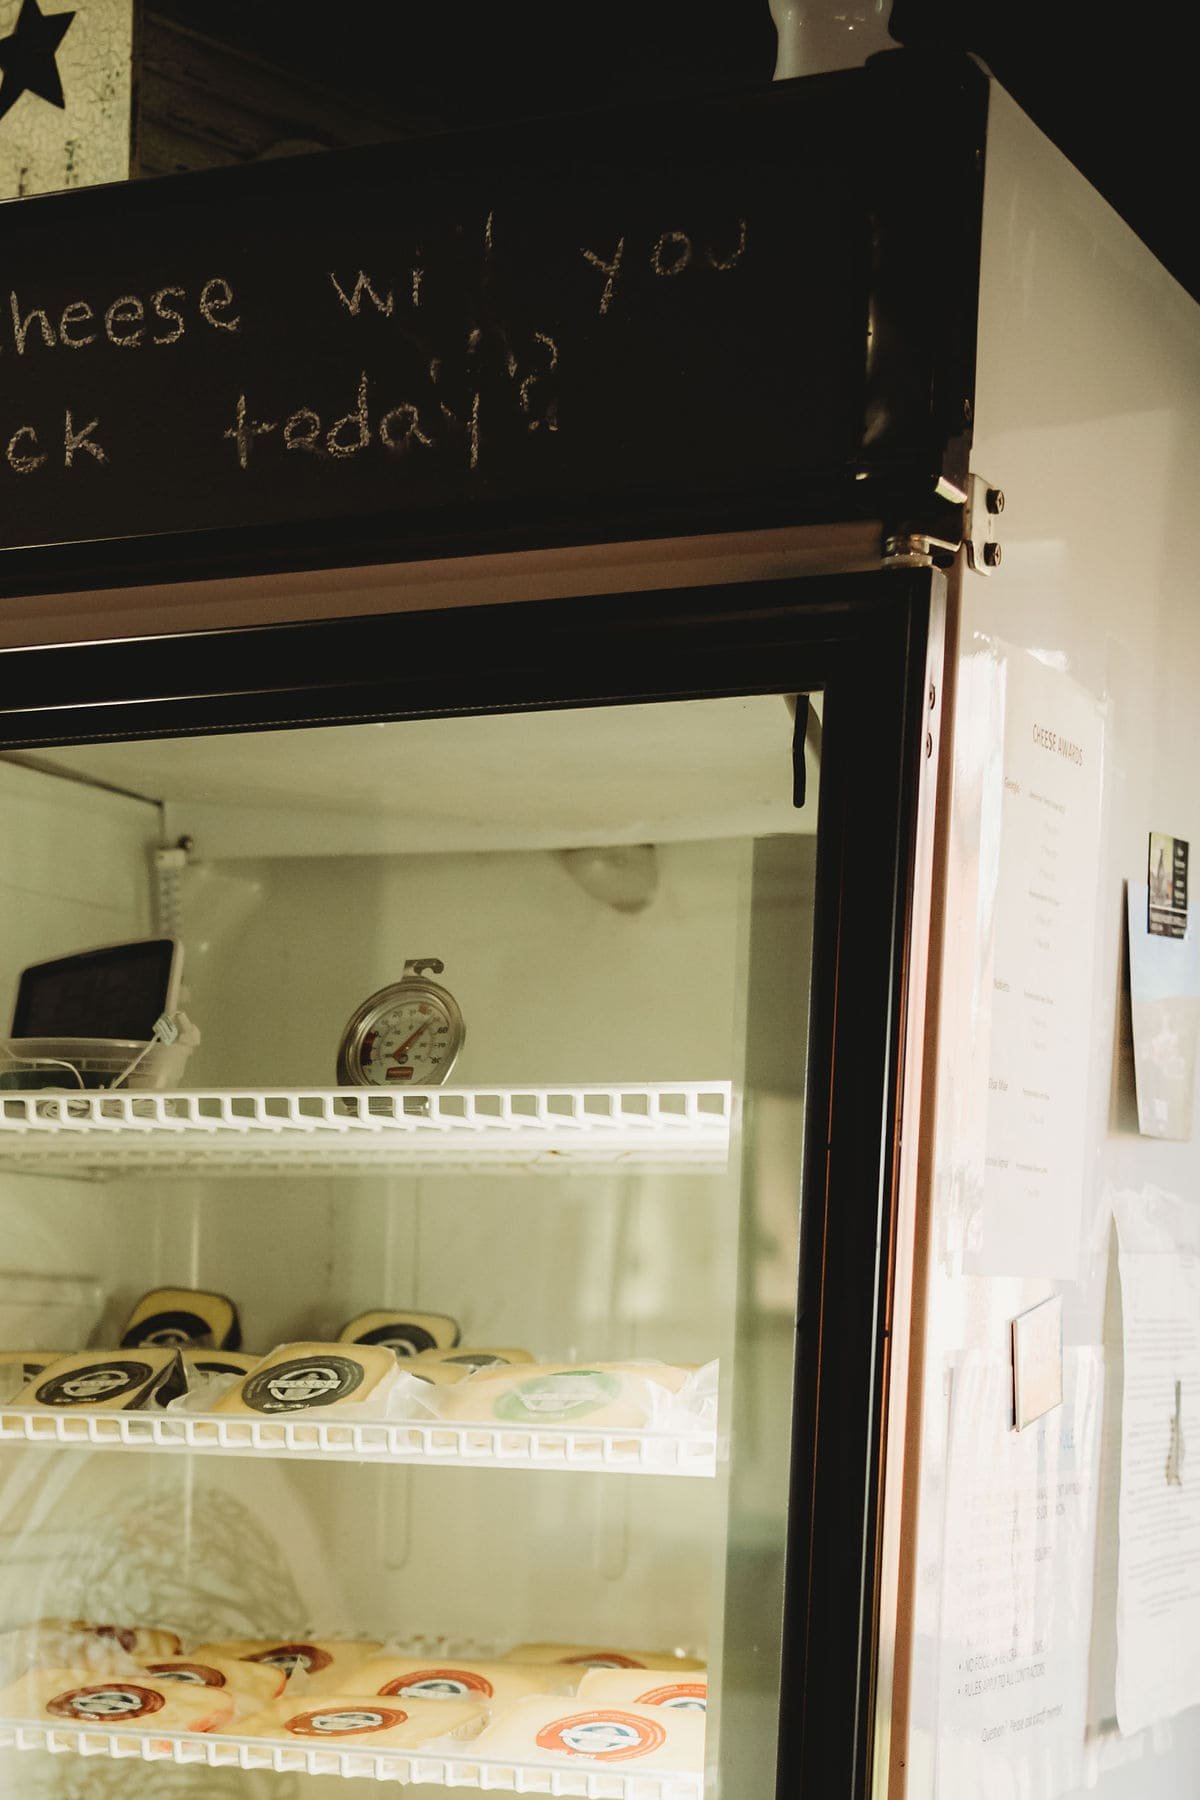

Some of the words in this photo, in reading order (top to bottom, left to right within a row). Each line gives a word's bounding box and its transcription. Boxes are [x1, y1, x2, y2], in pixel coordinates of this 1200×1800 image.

[581, 218, 747, 314] you
[1031, 723, 1057, 753] CHEESE
[1057, 736, 1084, 767] AWARDS
